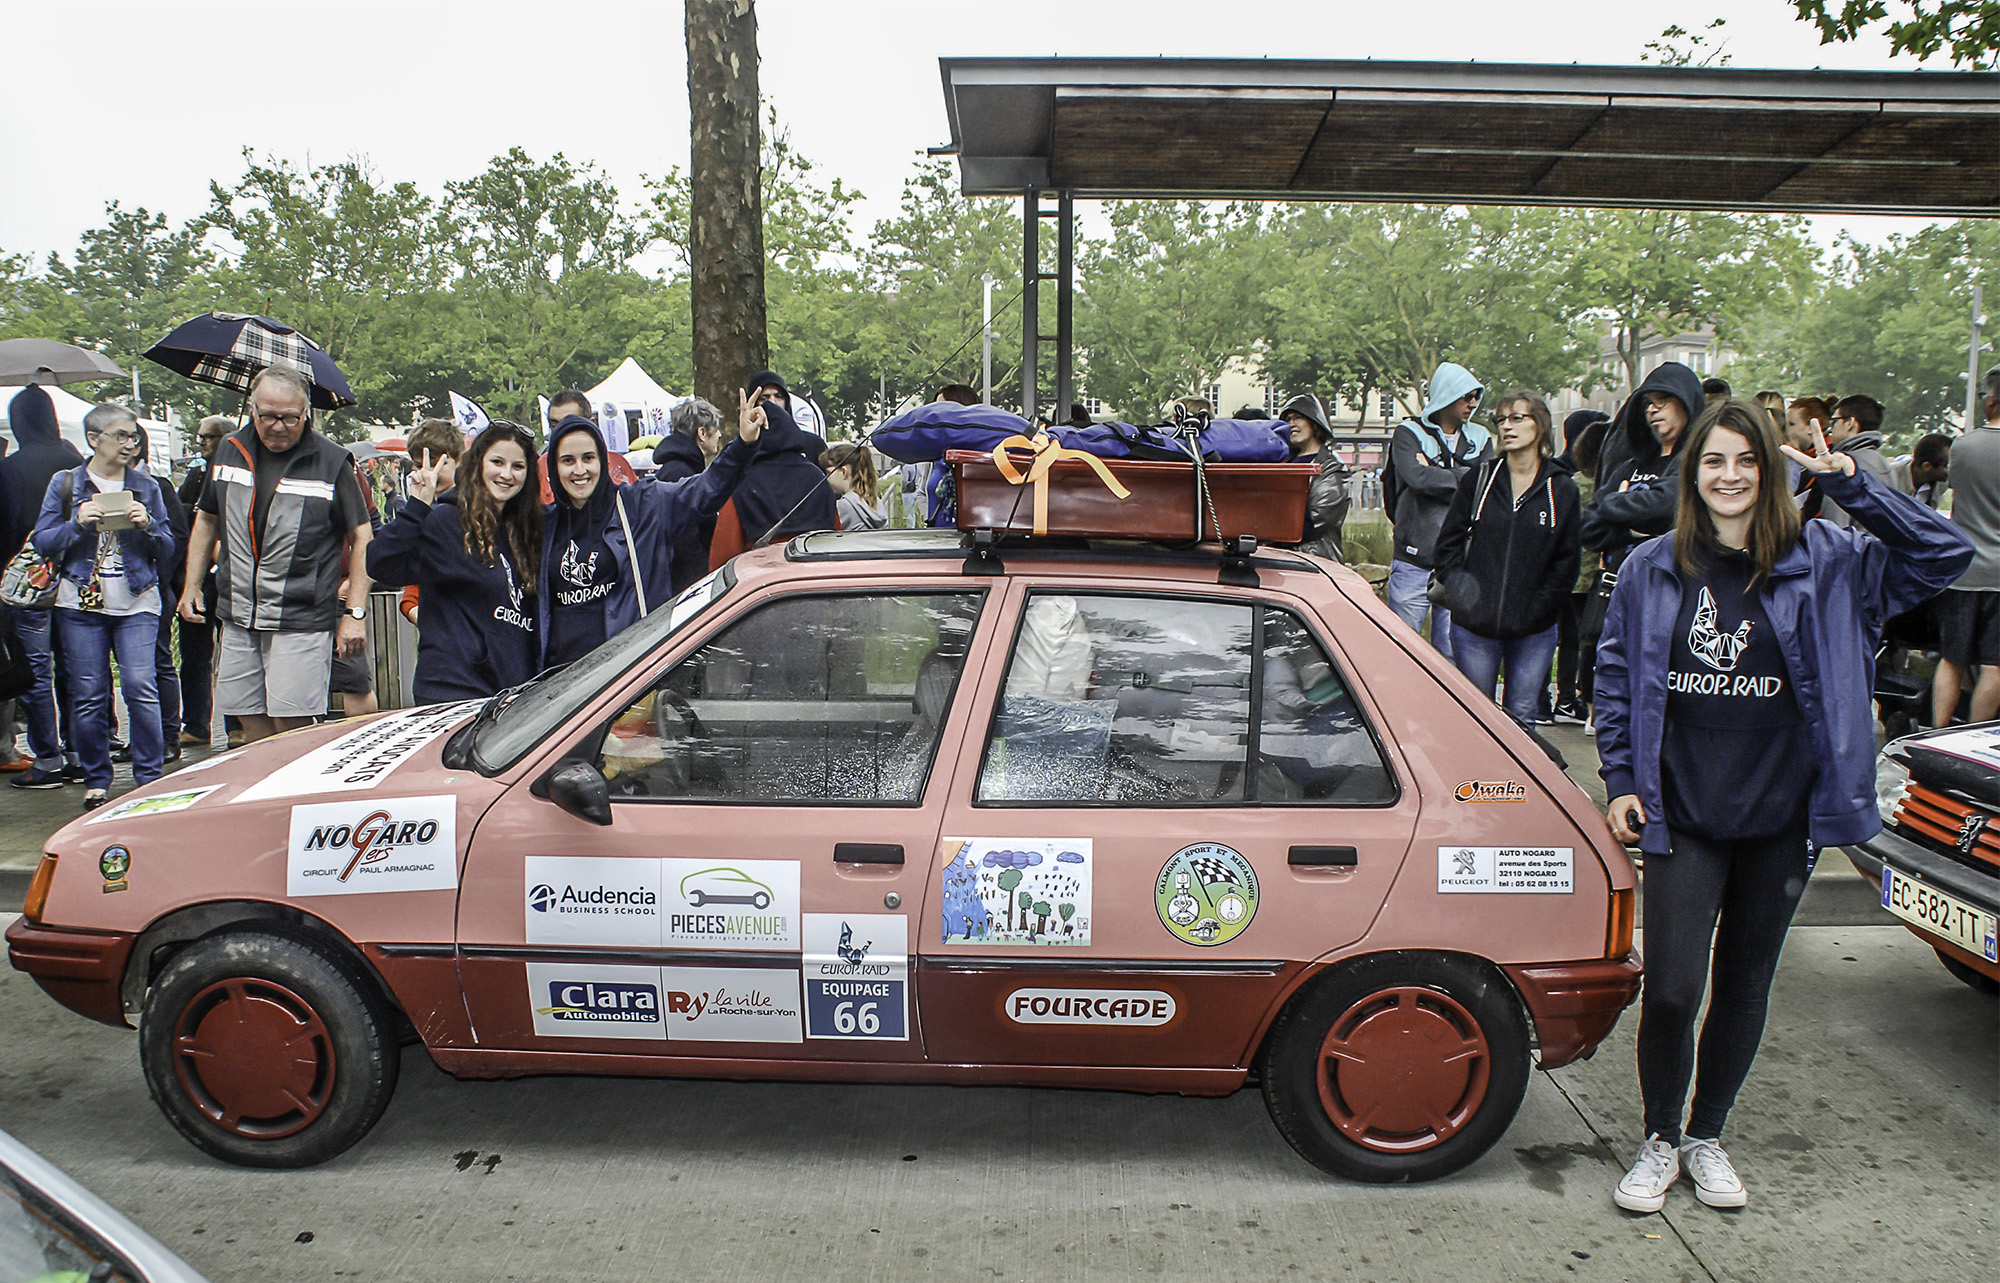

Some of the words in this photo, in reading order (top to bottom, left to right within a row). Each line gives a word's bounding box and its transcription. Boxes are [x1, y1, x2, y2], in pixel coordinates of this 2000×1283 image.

[1667, 671, 1783, 697] EUROP.RAID
[343, 736, 428, 784] AVOCATS
[304, 809, 440, 883] NOGARO
[303, 868, 338, 877] CIRCUIT
[360, 866, 382, 874] PAUL
[384, 863, 435, 873] ARMAGNAC
[1159, 857, 1182, 895] CALMONT
[1184, 846, 1212, 858] SPORT
[1216, 848, 1228, 856] ET
[1543, 860, 1567, 868] Sports
[560, 884, 656, 905] Audencia
[560, 906, 609, 914] BUSINESS
[614, 907, 656, 915] SCHOOL
[1892, 876, 1980, 944] EC-582-TT
[561, 983, 655, 1009] Clara
[711, 988, 733, 1006] la
[736, 989, 772, 1007] ville
[822, 982, 890, 998] EQUIPAGE
[563, 1010, 657, 1021] Automobiles
[719, 1007, 796, 1016] Roche-sur-Yon
[833, 1001, 880, 1035] 66
[1014, 996, 1168, 1020] FOURCADE
